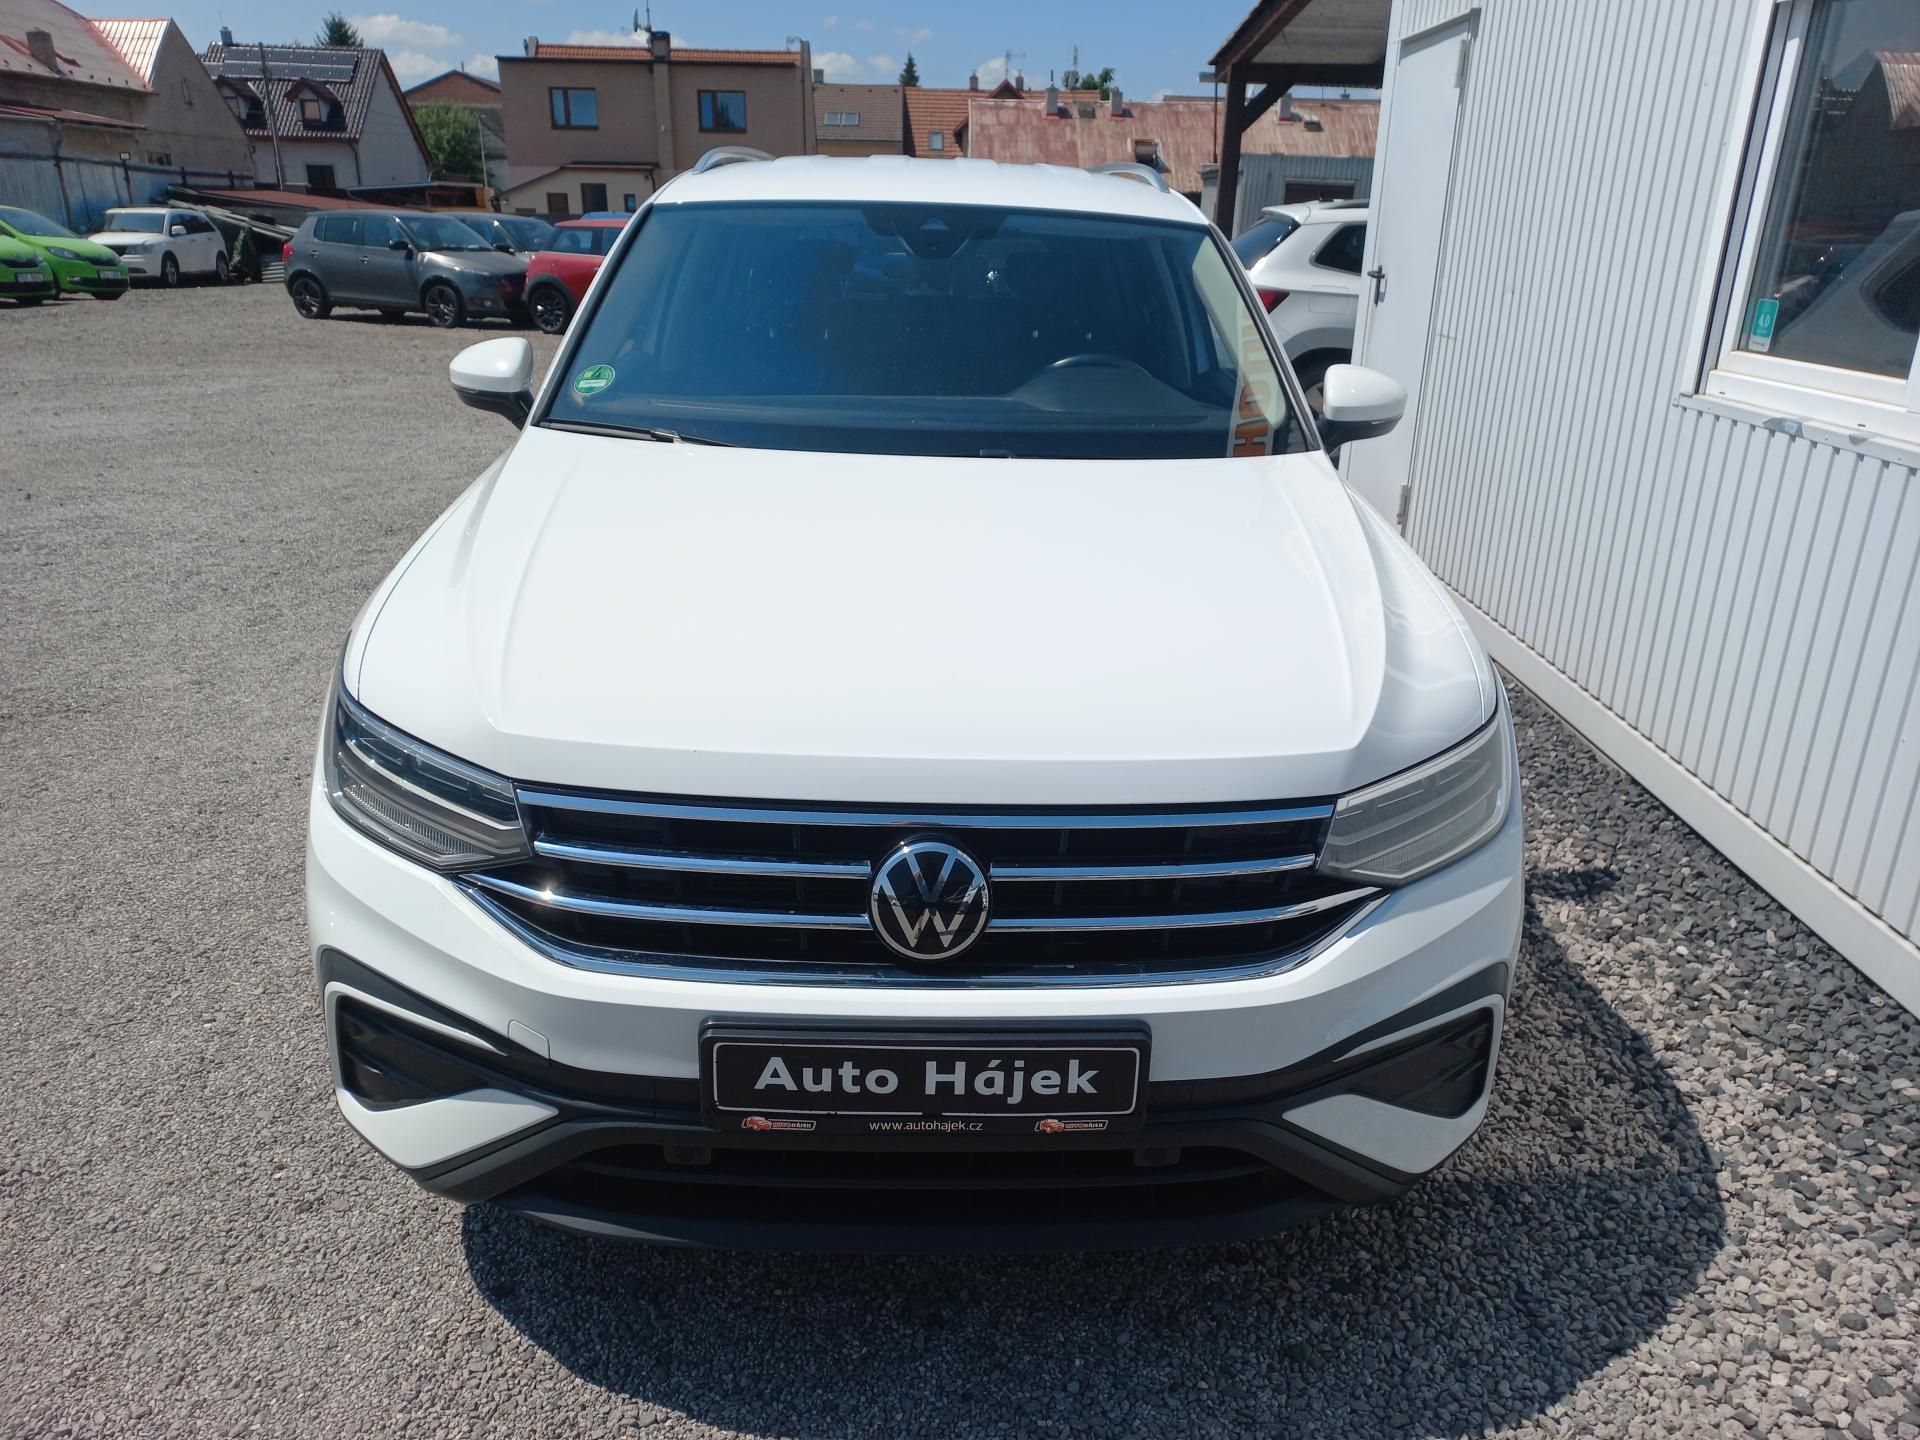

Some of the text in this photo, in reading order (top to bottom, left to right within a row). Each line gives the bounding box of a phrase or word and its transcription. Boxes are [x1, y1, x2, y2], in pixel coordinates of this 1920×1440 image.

[753, 1056, 1099, 1105] Auto Hájek
[869, 1120, 983, 1132] www.autohajek.cz
